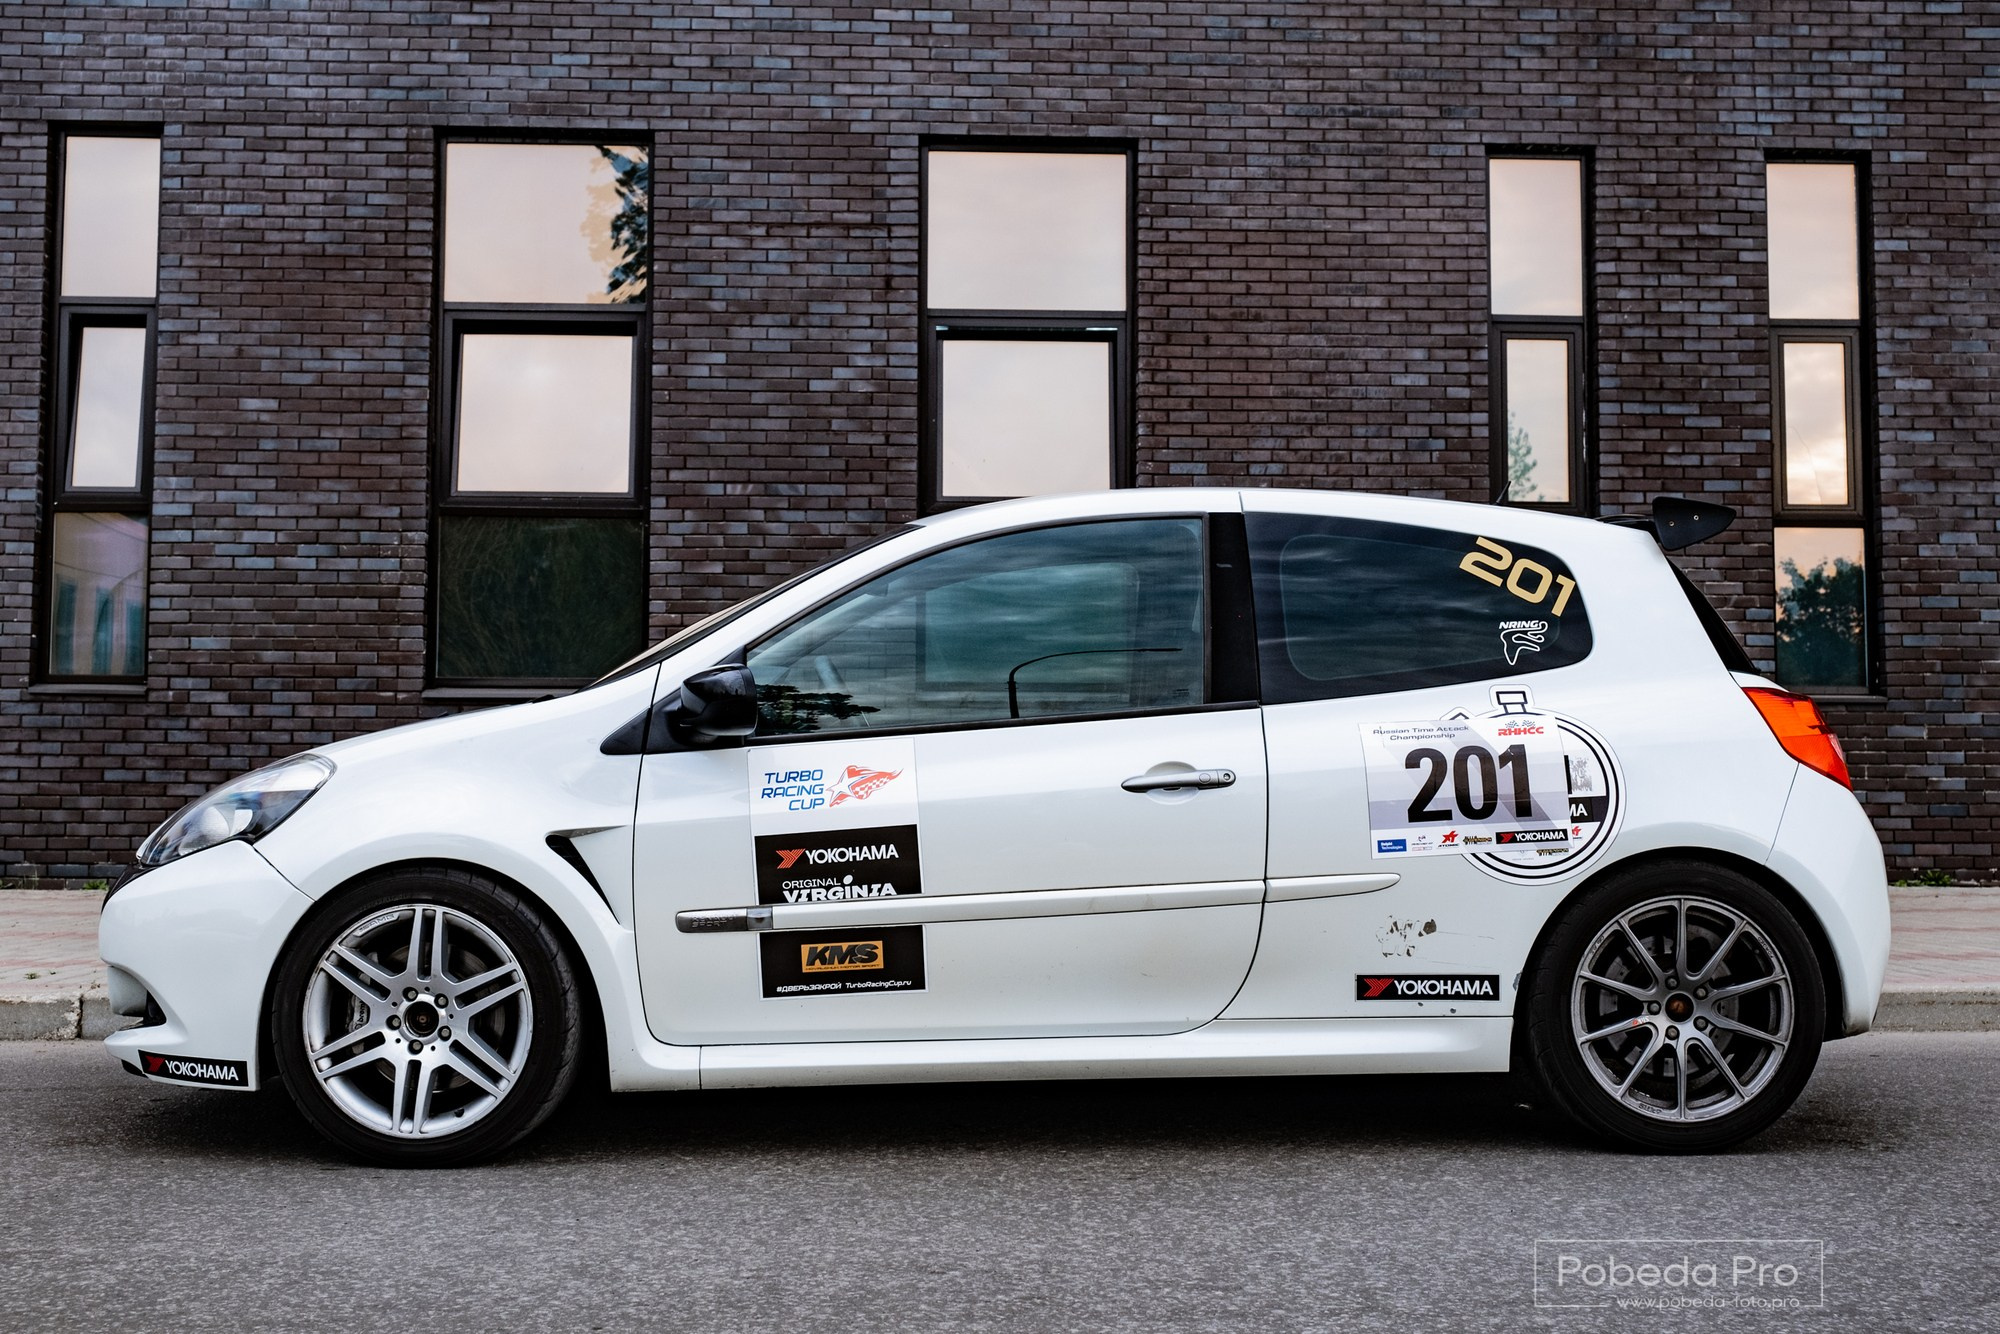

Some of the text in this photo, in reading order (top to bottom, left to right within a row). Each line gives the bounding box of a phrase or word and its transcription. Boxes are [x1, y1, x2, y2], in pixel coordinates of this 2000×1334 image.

[1459, 536, 1576, 617] 201
[1499, 620, 1540, 629] NRING
[1373, 727, 1410, 735] Russian
[1389, 732, 1456, 741] Championship
[764, 769, 824, 784] TURBO
[1404, 743, 1533, 823] 201
[761, 783, 825, 799] RACING
[788, 798, 825, 811] CUP
[1515, 830, 1566, 842] YOKOHAMA
[805, 844, 899, 865] YOKOHAMA
[782, 877, 842, 889] ORIGINAL
[805, 943, 880, 967] KMS
[845, 980, 912, 989] TurboRacingCup.ru
[1394, 980, 1493, 995] YOKOHAMA
[165, 1059, 239, 1081] YOKOHAMA
